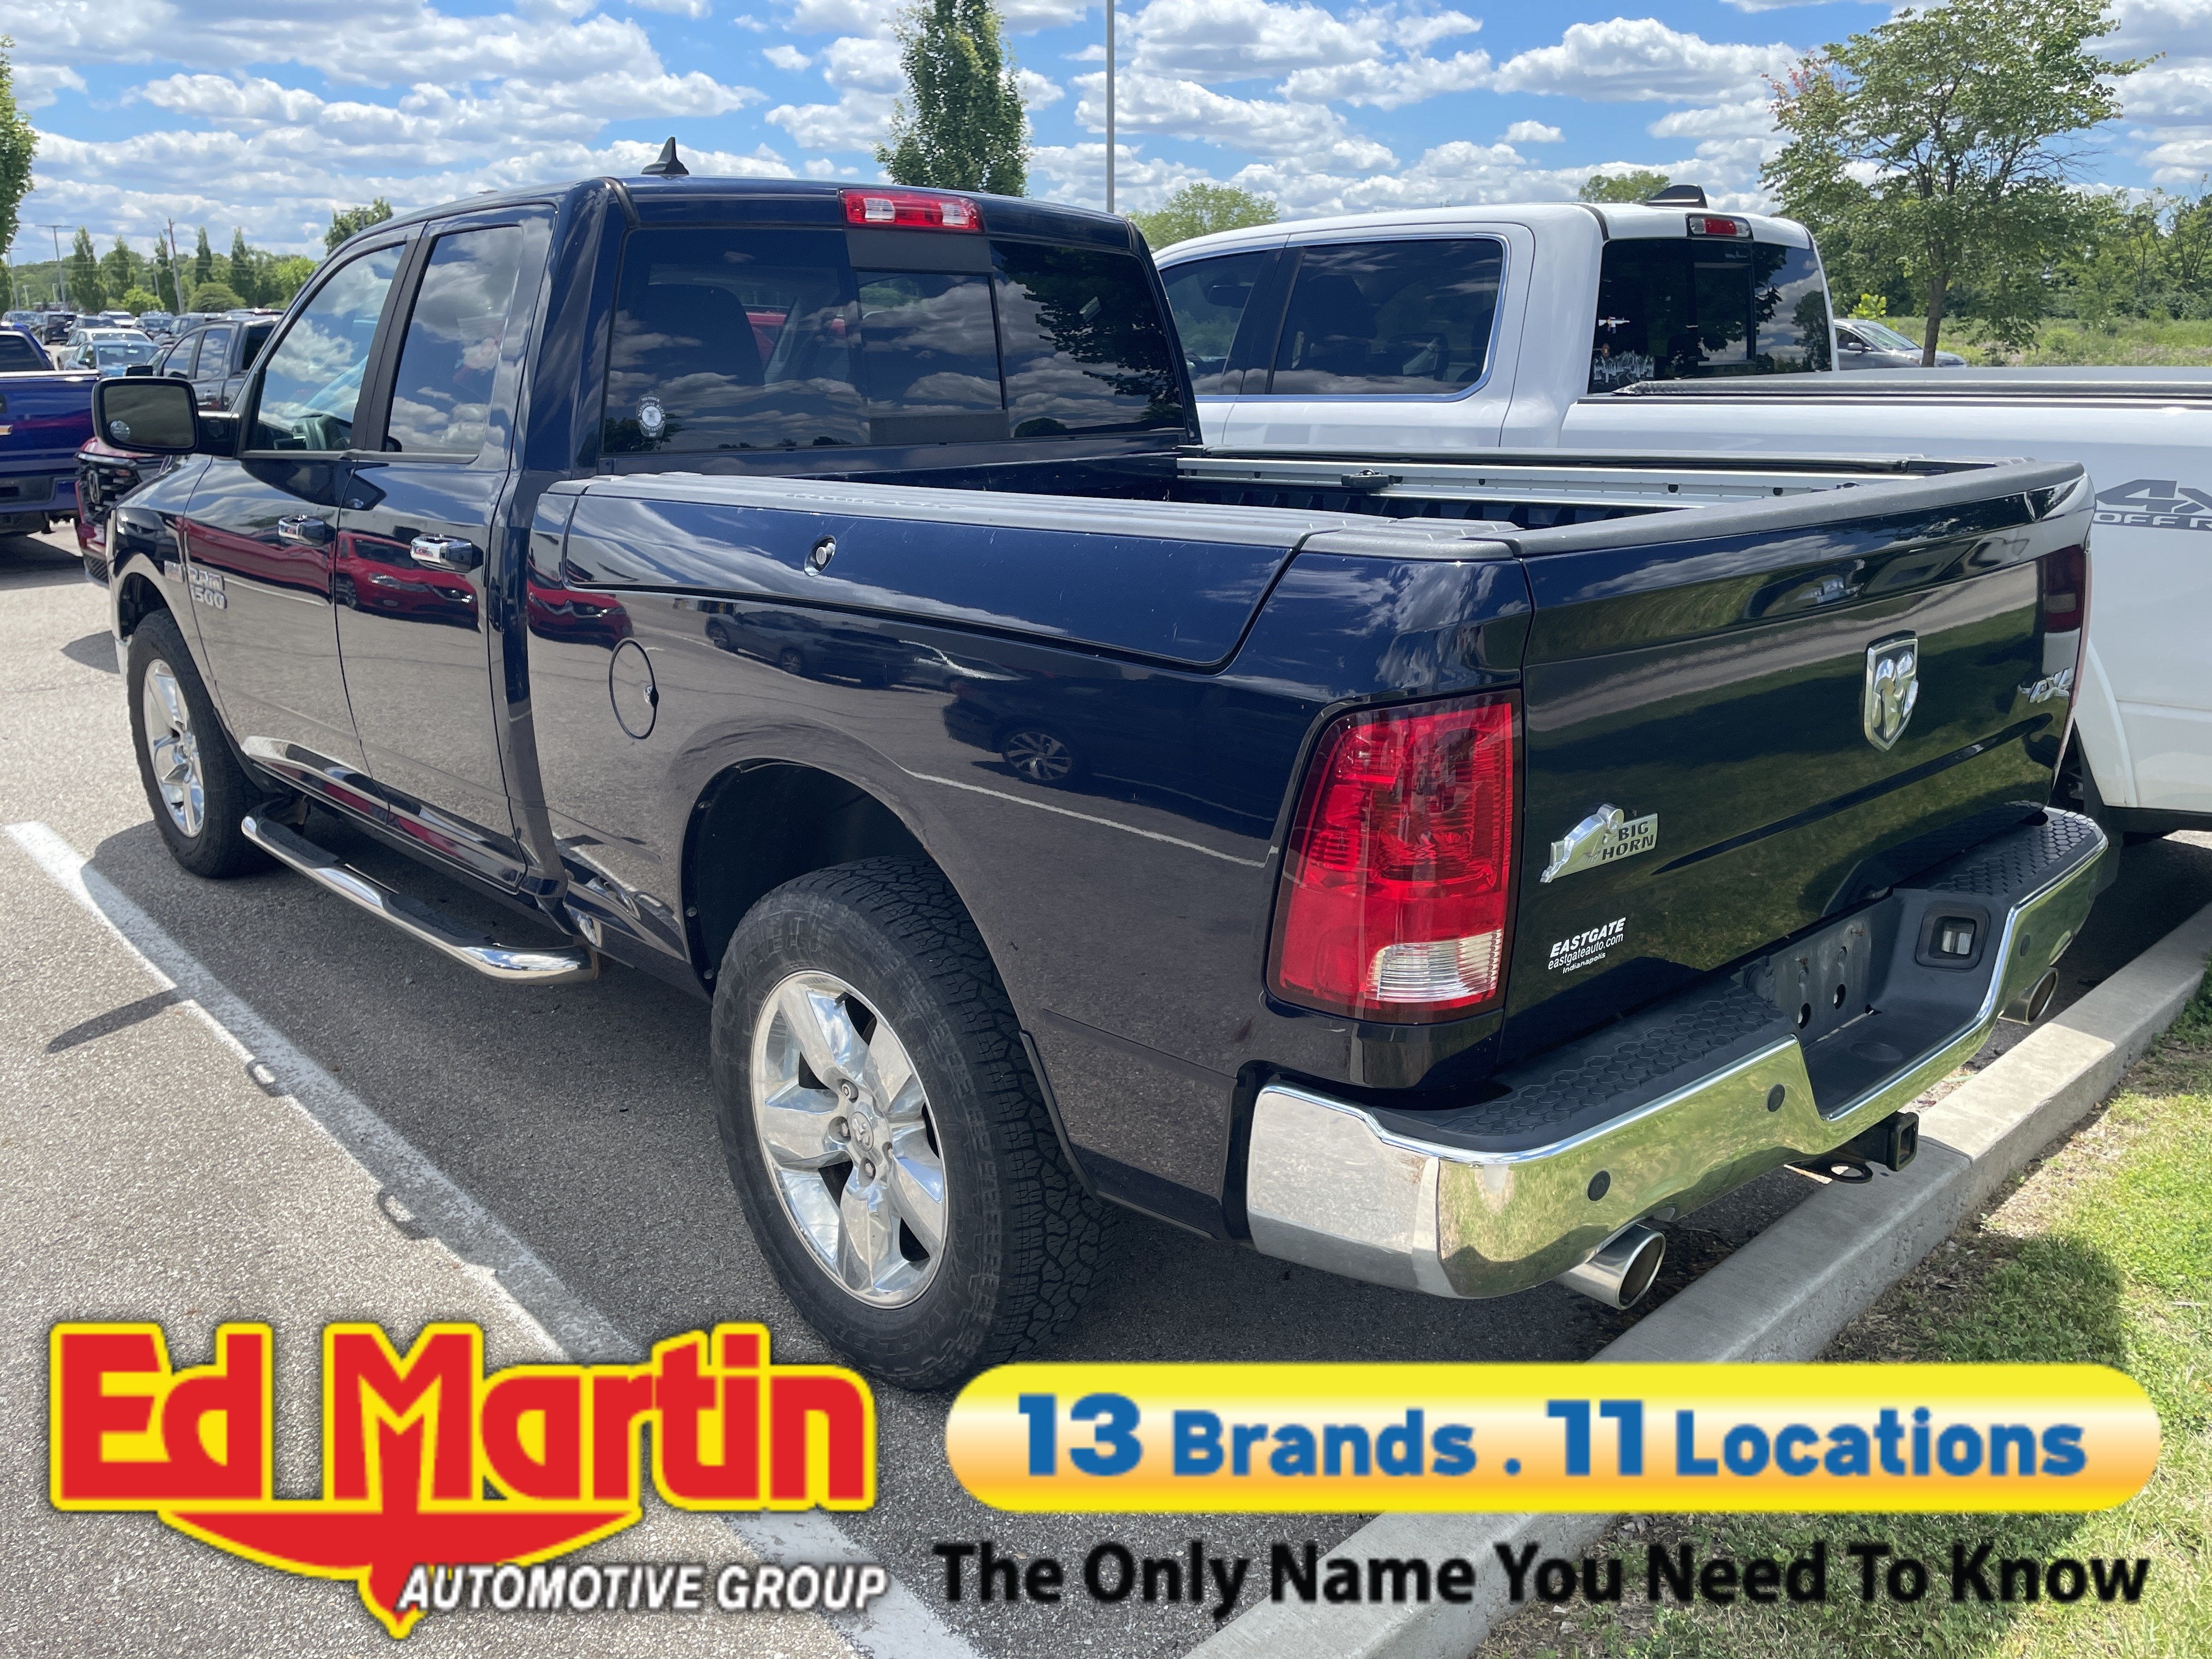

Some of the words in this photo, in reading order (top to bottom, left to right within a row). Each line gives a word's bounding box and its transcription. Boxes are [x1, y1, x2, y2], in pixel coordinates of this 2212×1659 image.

[190, 584, 227, 610] 1500
[1618, 821, 1649, 842] BIG
[1601, 834, 1654, 861] HORN
[1550, 917, 1626, 958] EASTGATE
[1548, 933, 1623, 970] eastgateauto.com
[1562, 952, 1606, 974] Indianapolis
